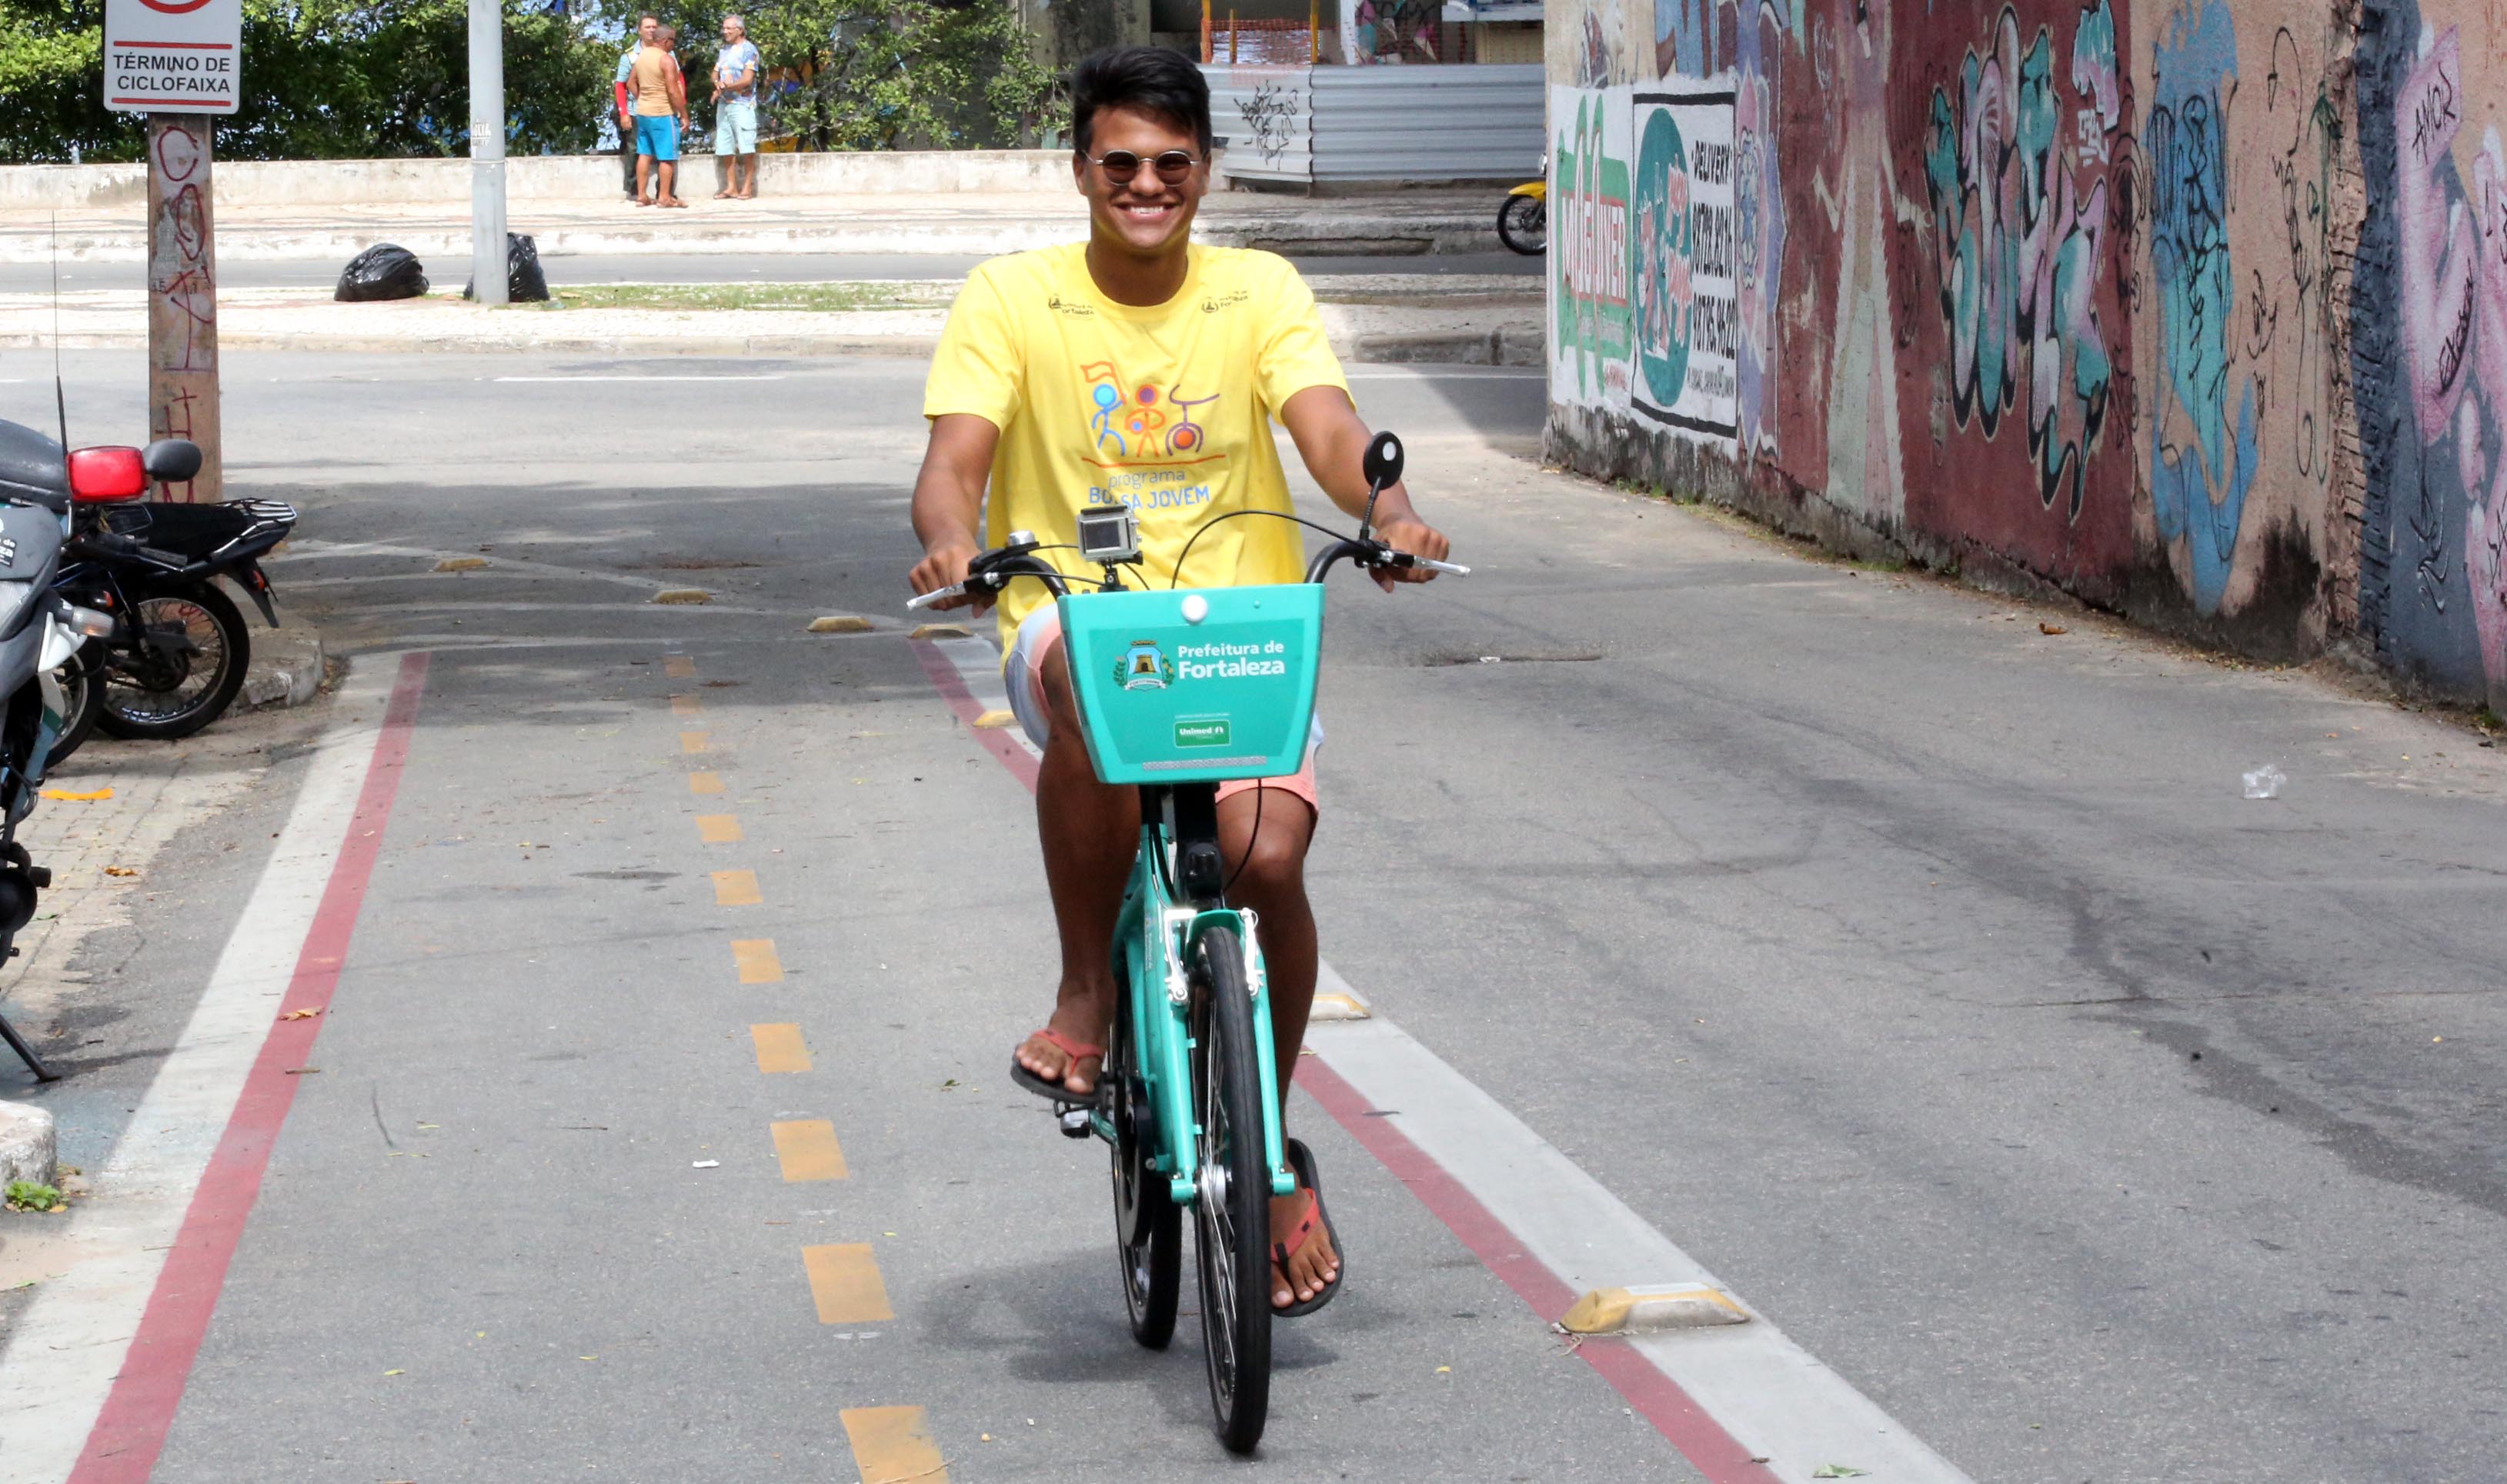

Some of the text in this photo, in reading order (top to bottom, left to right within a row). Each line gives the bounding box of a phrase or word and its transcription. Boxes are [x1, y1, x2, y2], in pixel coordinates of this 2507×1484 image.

[113, 52, 230, 72] TÉRMINO DE
[118, 75, 231, 92] CICLOFAIXA
[2412, 61, 2455, 165] AMOR
[1109, 469, 1186, 491] programa
[1089, 485, 1210, 509] BOSA JOVEM
[1177, 640, 1284, 658] Prefeitura de
[1178, 657, 1286, 679] Fortaleza
[1179, 726, 1213, 735] Unimed
